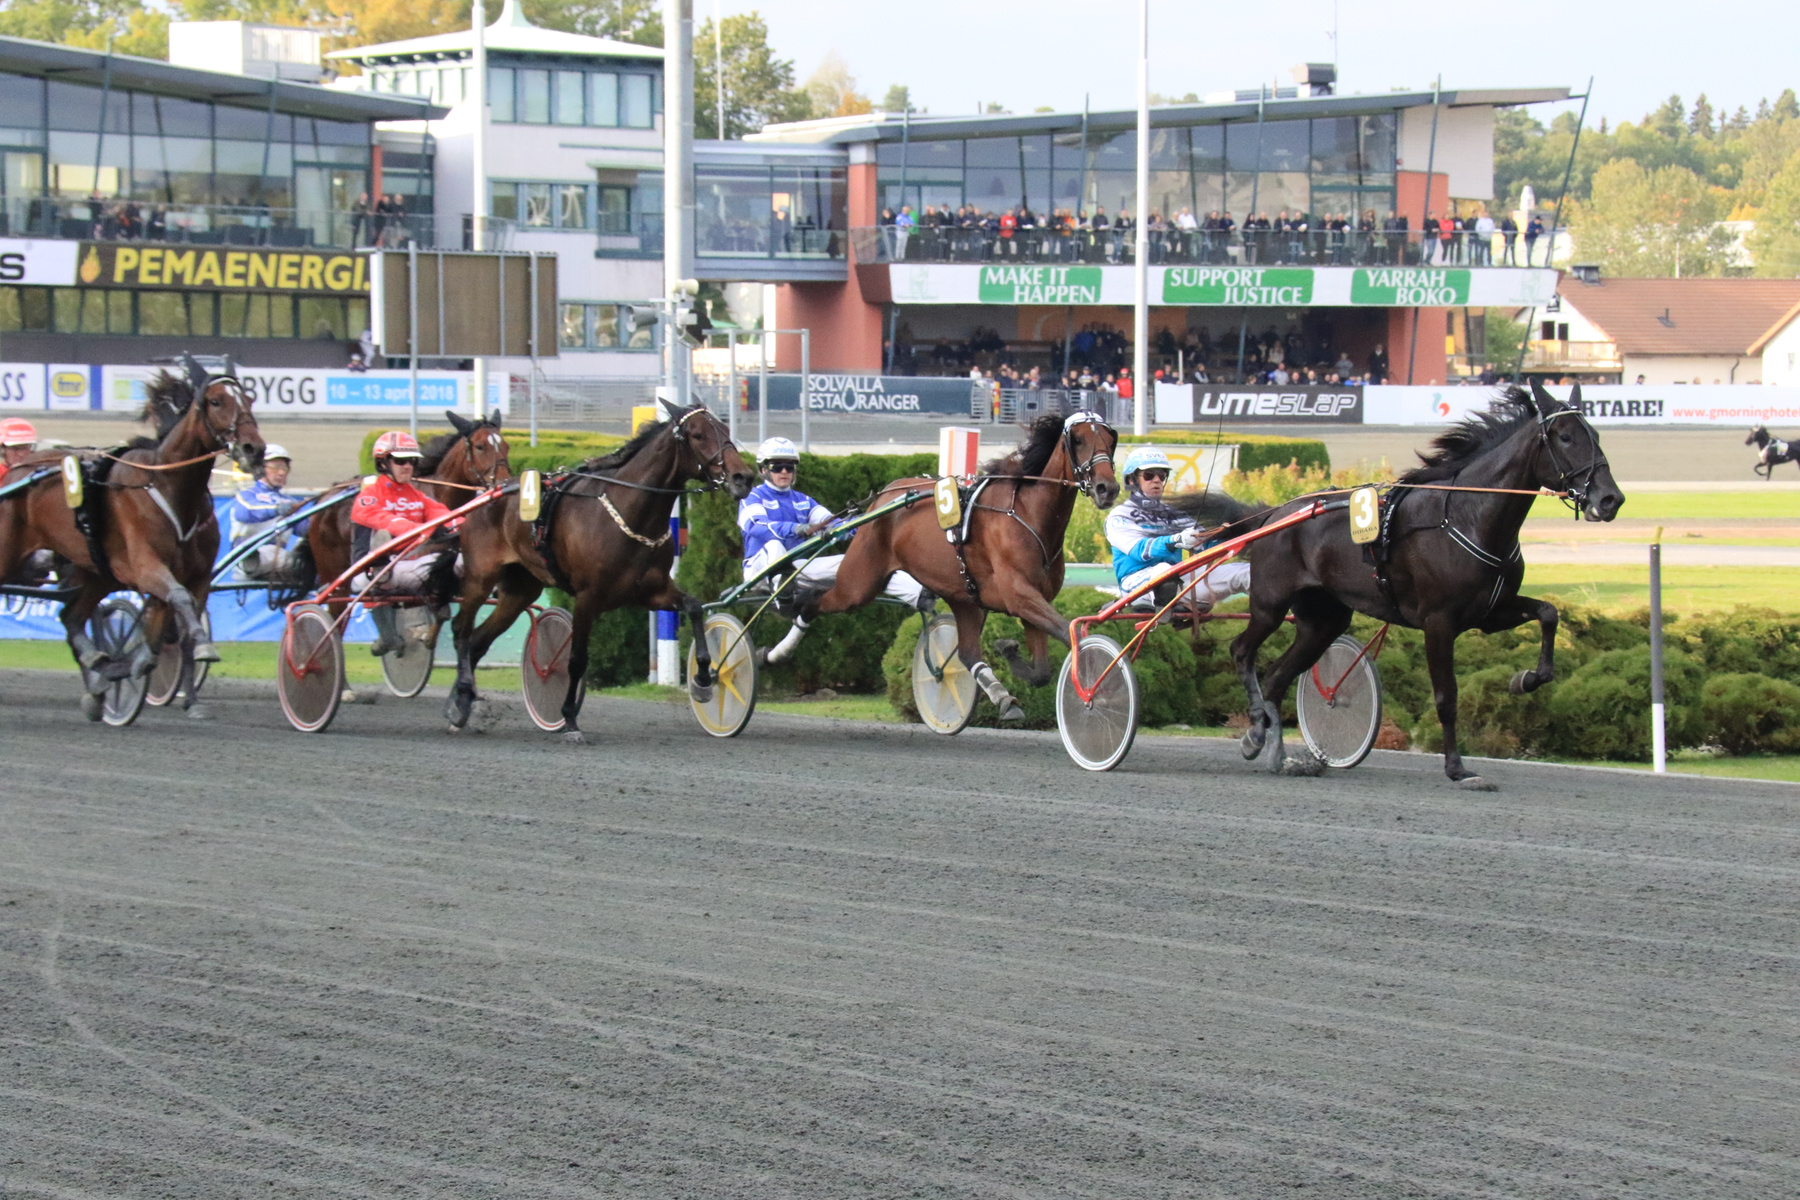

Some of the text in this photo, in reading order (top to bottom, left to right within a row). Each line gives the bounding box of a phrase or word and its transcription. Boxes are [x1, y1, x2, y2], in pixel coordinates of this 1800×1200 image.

[985, 267, 1070, 285] MAKE IT
[1170, 269, 1266, 287] SUPPORT
[1366, 270, 1447, 287] YARRAH
[1013, 285, 1096, 303] HAPPEN
[1223, 286, 1303, 304] JUSTICE
[1396, 287, 1456, 305] BOKO
[807, 375, 884, 393] SOLVALLA
[330, 384, 347, 399] 10
[363, 384, 381, 400] 13
[384, 385, 413, 403] apri
[420, 385, 455, 401] 2018
[64, 455, 79, 494] 9
[522, 469, 536, 505] 4
[938, 477, 954, 514] 5
[1354, 488, 1373, 528] 3
